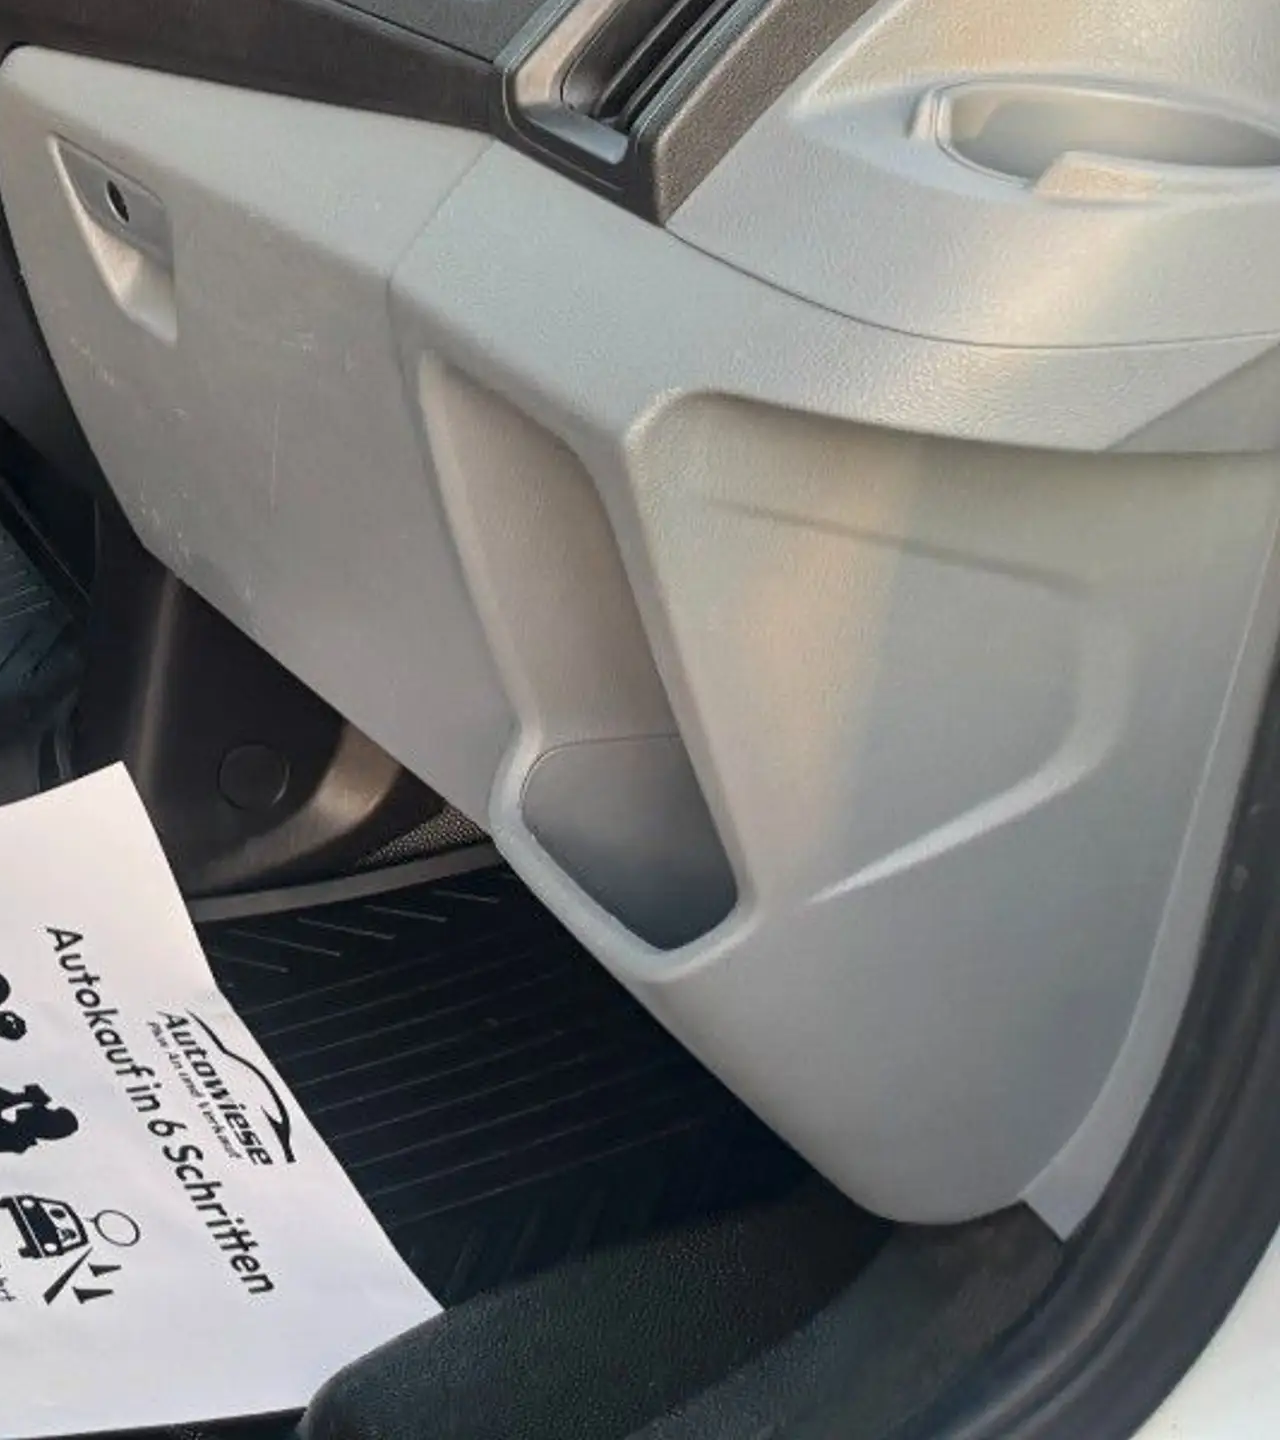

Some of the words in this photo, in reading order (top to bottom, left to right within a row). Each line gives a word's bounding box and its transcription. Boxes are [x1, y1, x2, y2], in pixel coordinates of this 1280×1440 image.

[46, 926, 156, 1076] Autokauf
[125, 1082, 162, 1112] in
[147, 1119, 188, 1137] 6
[155, 1011, 273, 1166] Autowiese
[163, 1143, 275, 1295] Schritten
